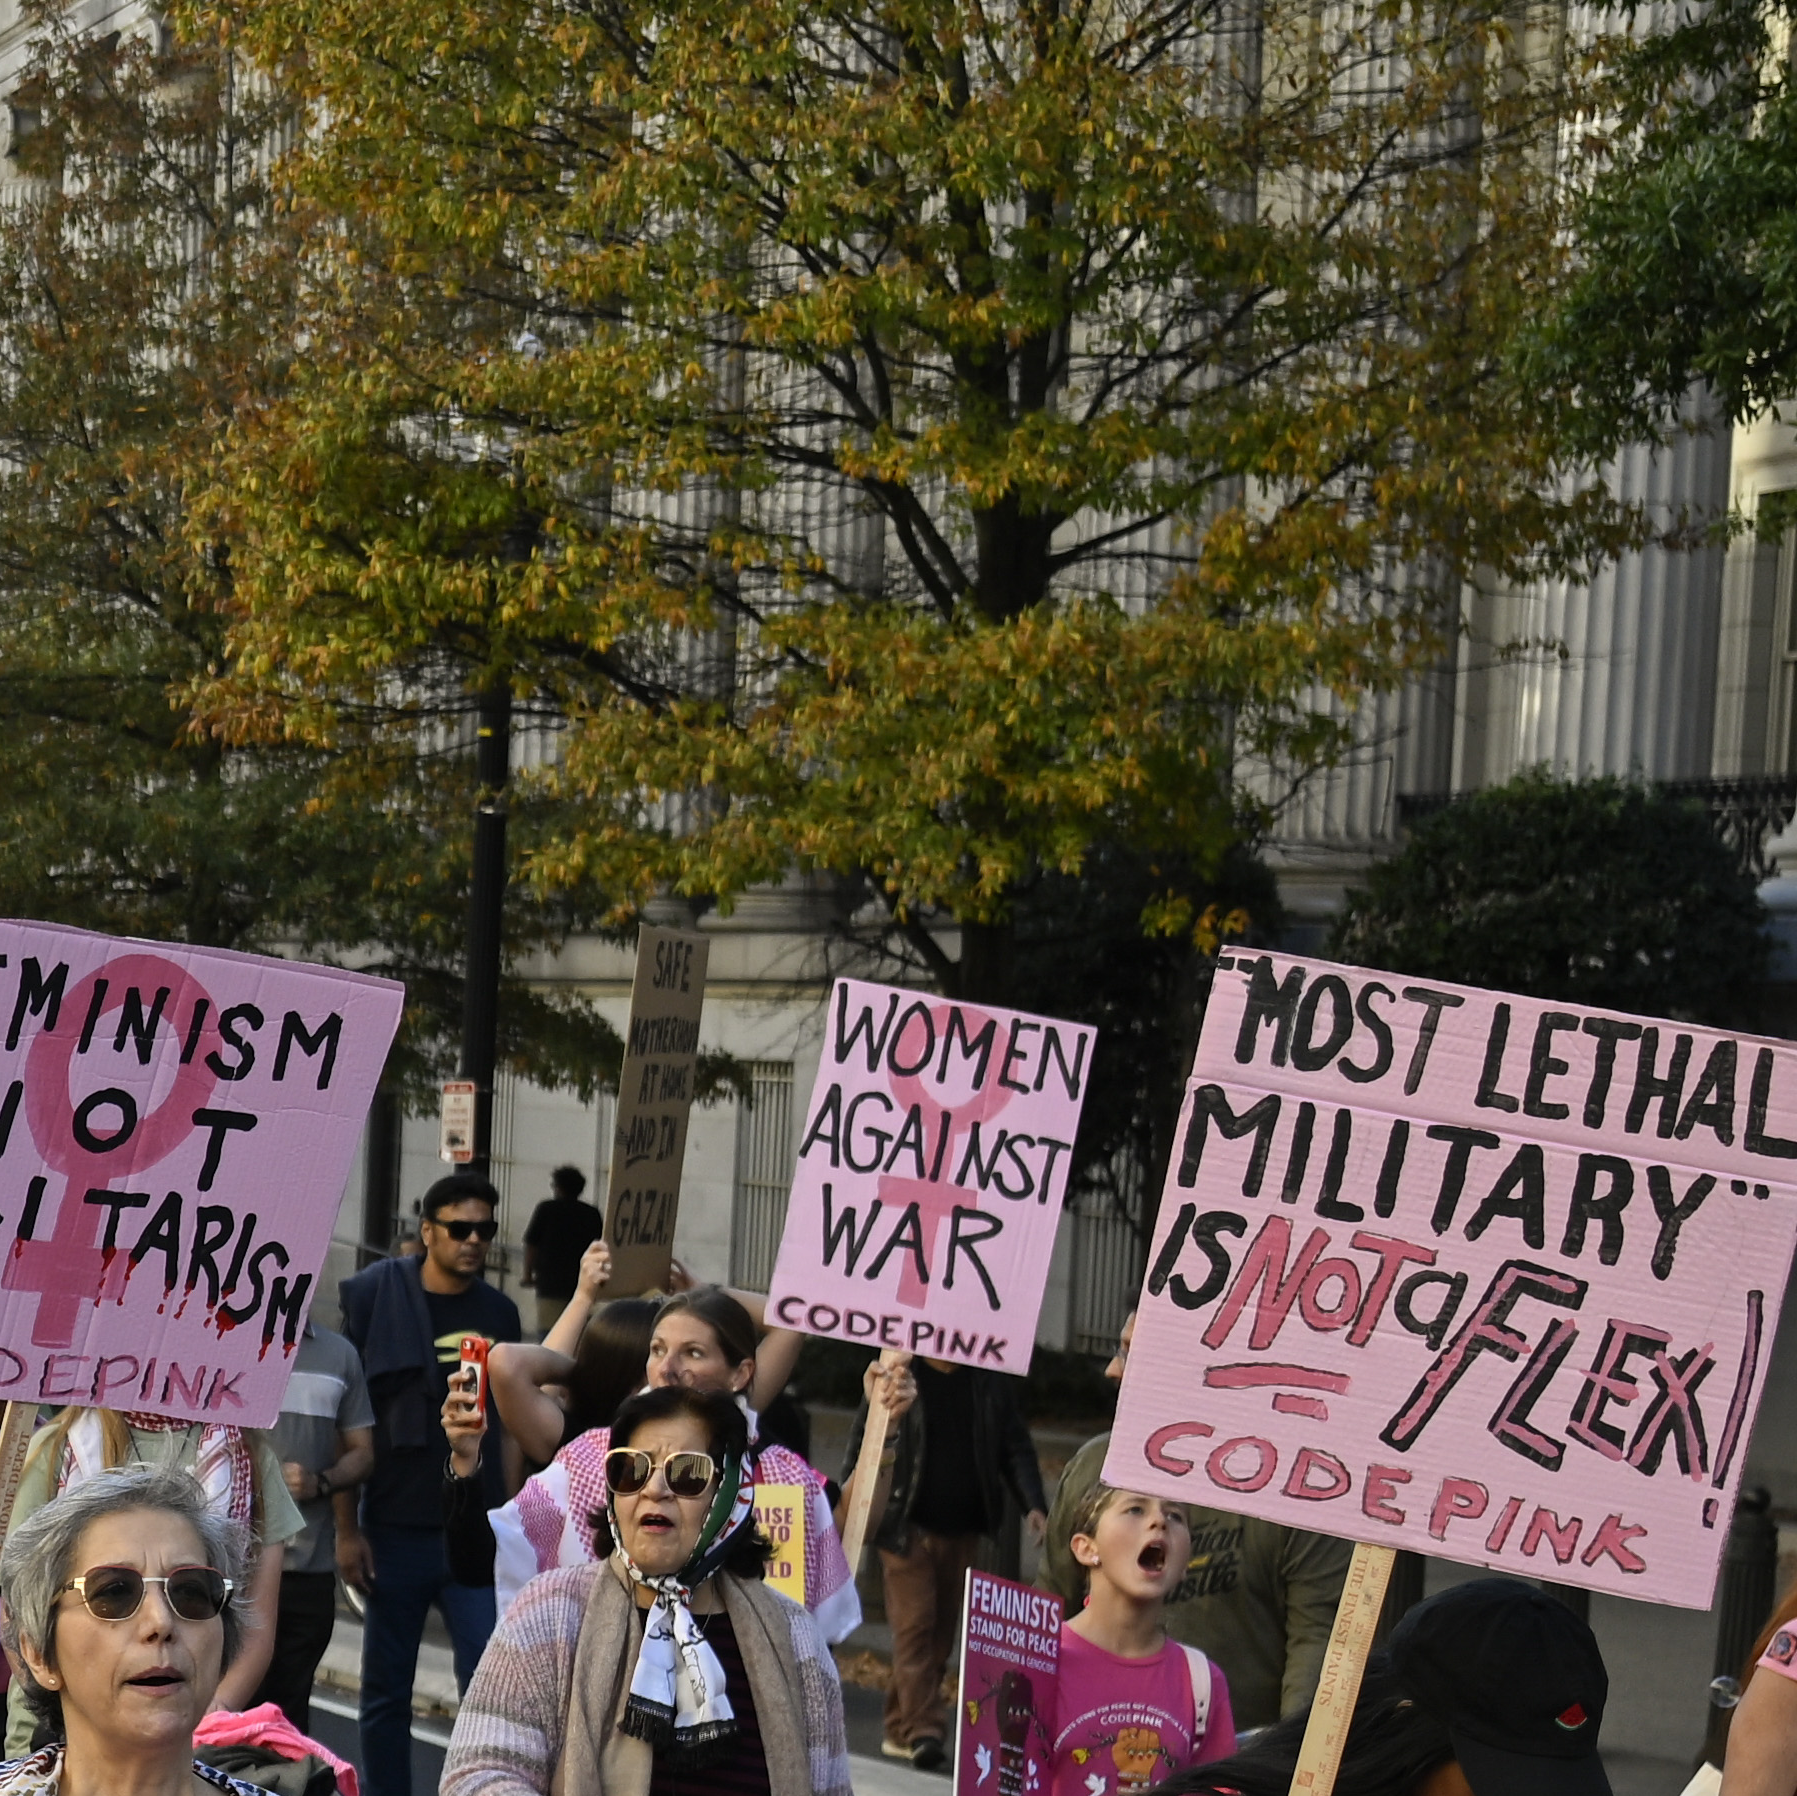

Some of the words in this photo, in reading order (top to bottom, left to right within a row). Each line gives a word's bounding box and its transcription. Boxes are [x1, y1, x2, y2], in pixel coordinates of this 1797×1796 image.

[653, 940, 693, 993] SAFE
[835, 982, 1088, 1100] WOMEN
[638, 1062, 659, 1104] AT
[800, 1084, 1070, 1204] AGAINST
[822, 1184, 1001, 1310] WAR
[776, 1296, 1009, 1363] CODEPINK
[1201, 1214, 1437, 1351] NOT
[1380, 1260, 1764, 1528] FLEX!
[8, 1430, 31, 1486] DEPOT
[1145, 1420, 1649, 1574] CODEPINK
[1349, 1557, 1370, 1589] THE
[971, 1578, 1060, 1634] FEMINISTS
[1334, 1591, 1359, 1649] FINEST
[969, 1615, 1004, 1641] STAND
[1005, 1626, 1026, 1649] FOR
[1028, 1632, 1058, 1658] PEACE
[969, 1640, 982, 1652] NOT
[1317, 1650, 1343, 1708] PAINTS
[1100, 1713, 1163, 1728] CODEPINK
